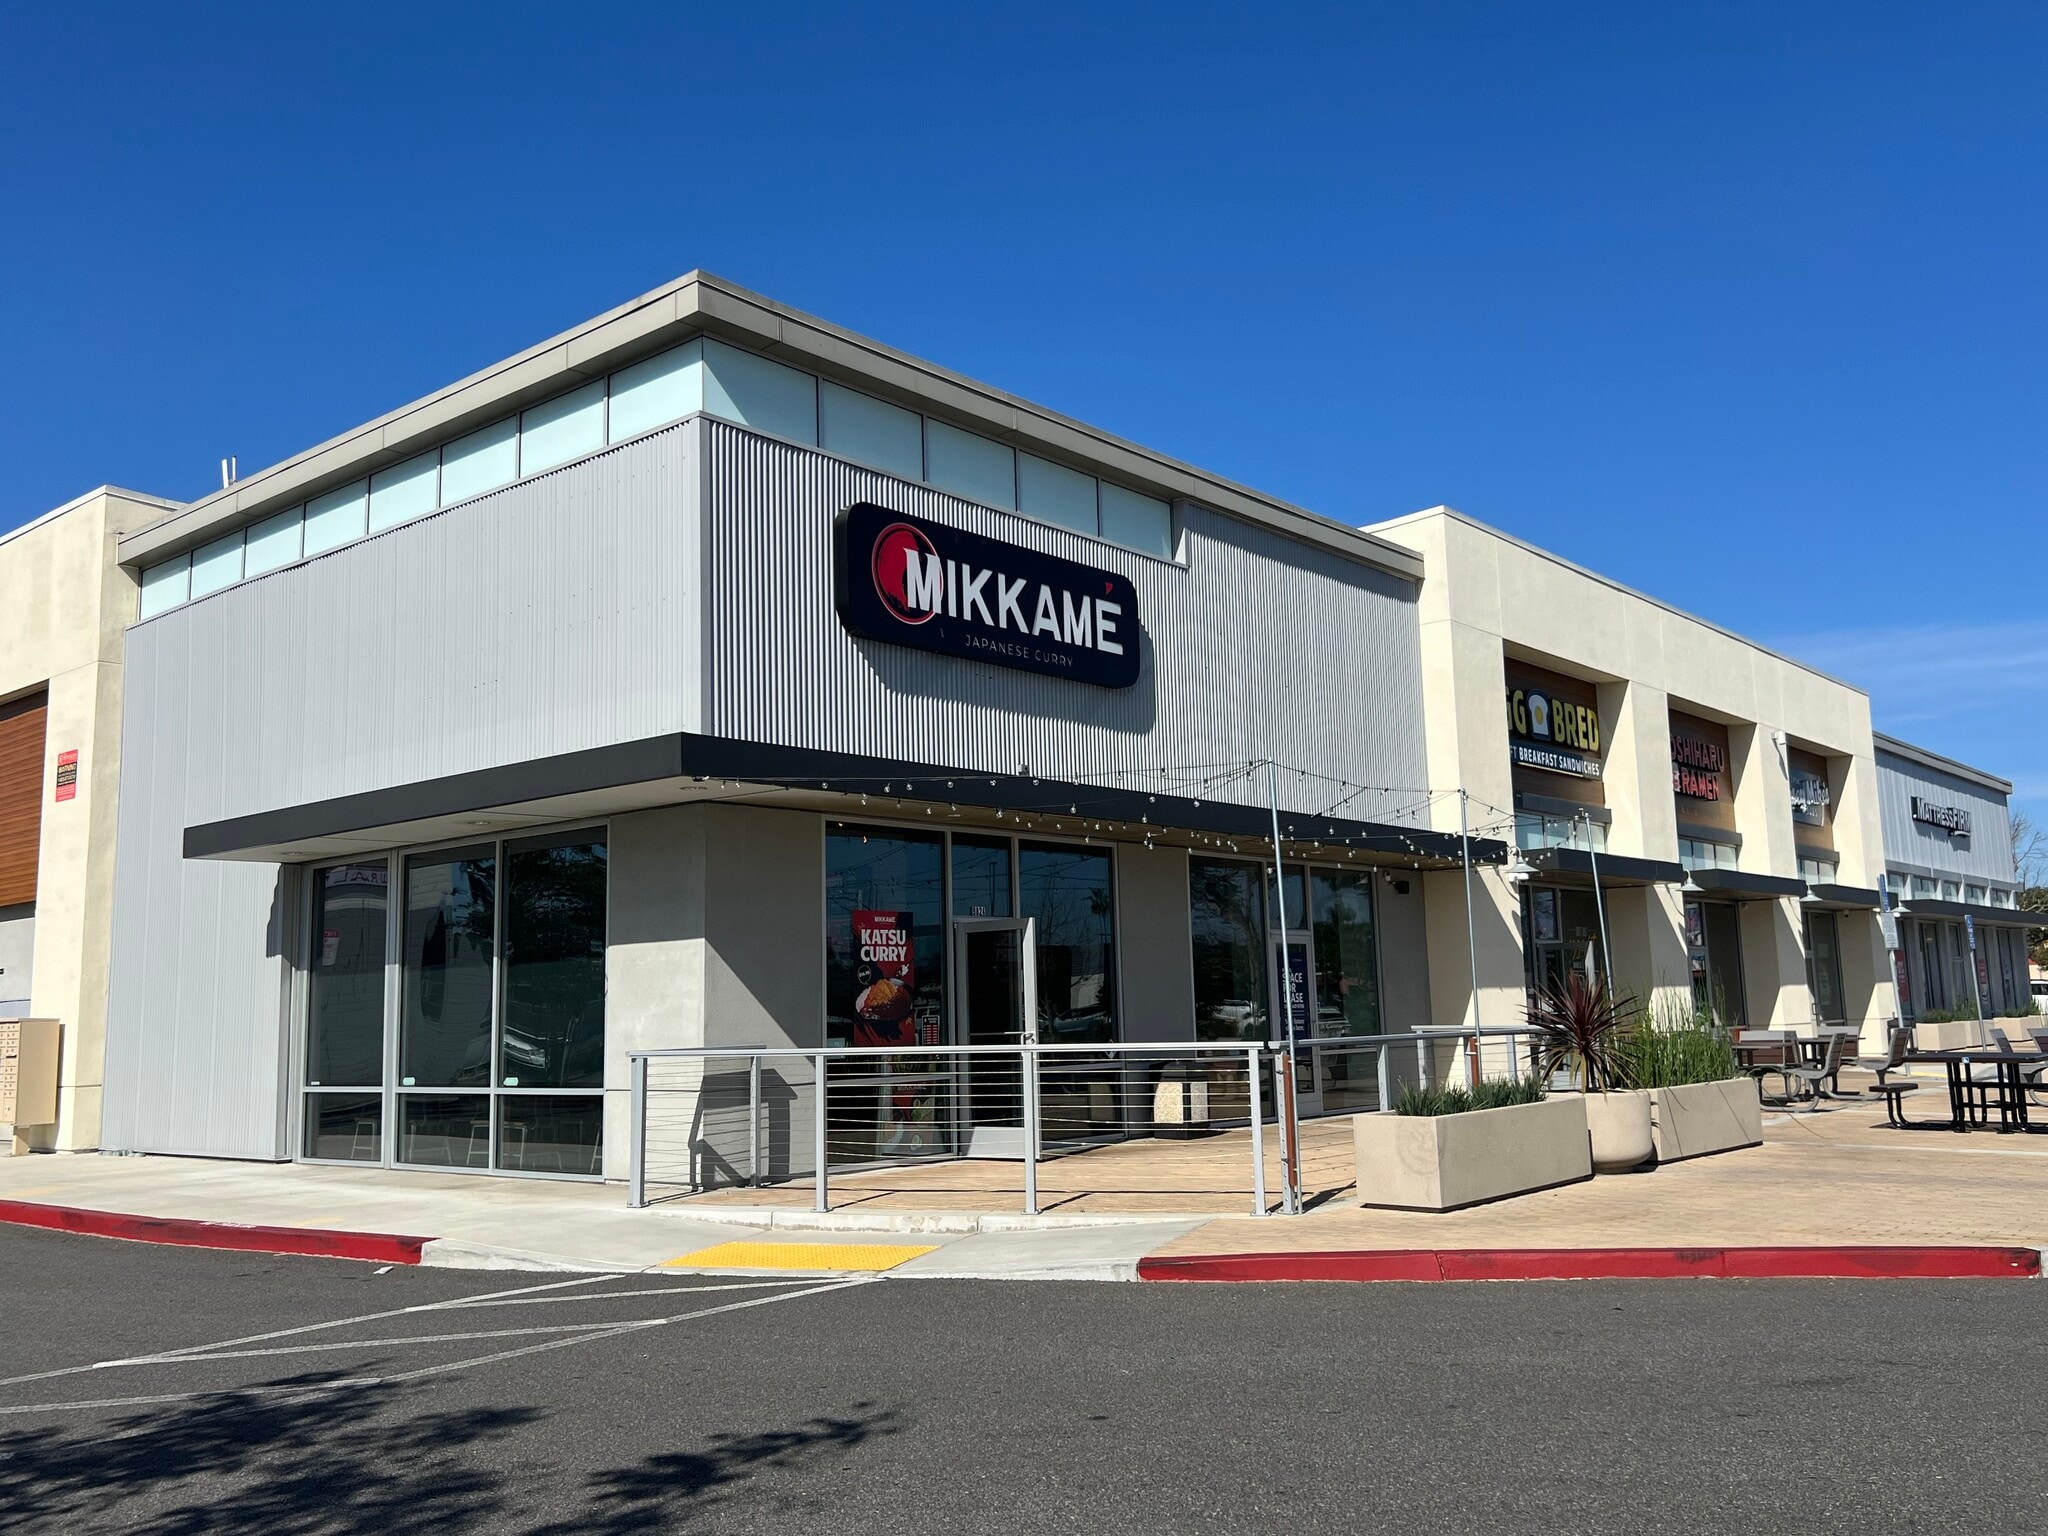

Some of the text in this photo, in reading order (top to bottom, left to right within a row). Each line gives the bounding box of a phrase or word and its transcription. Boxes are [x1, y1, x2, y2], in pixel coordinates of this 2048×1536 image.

[903, 547, 1123, 656] MIKKAMÉ
[965, 634, 1073, 667] JAPANESE CURRY
[1551, 699, 1599, 752] BRED
[1519, 747, 1558, 768] BREAKFAST
[1559, 755, 1600, 777] SANDWICHES
[1681, 766, 1719, 801] RAMEN
[861, 928, 907, 945] KATSU
[860, 945, 908, 962] CURRY
[1282, 972, 1303, 983] SACE
[1283, 992, 1304, 1003] LASE
